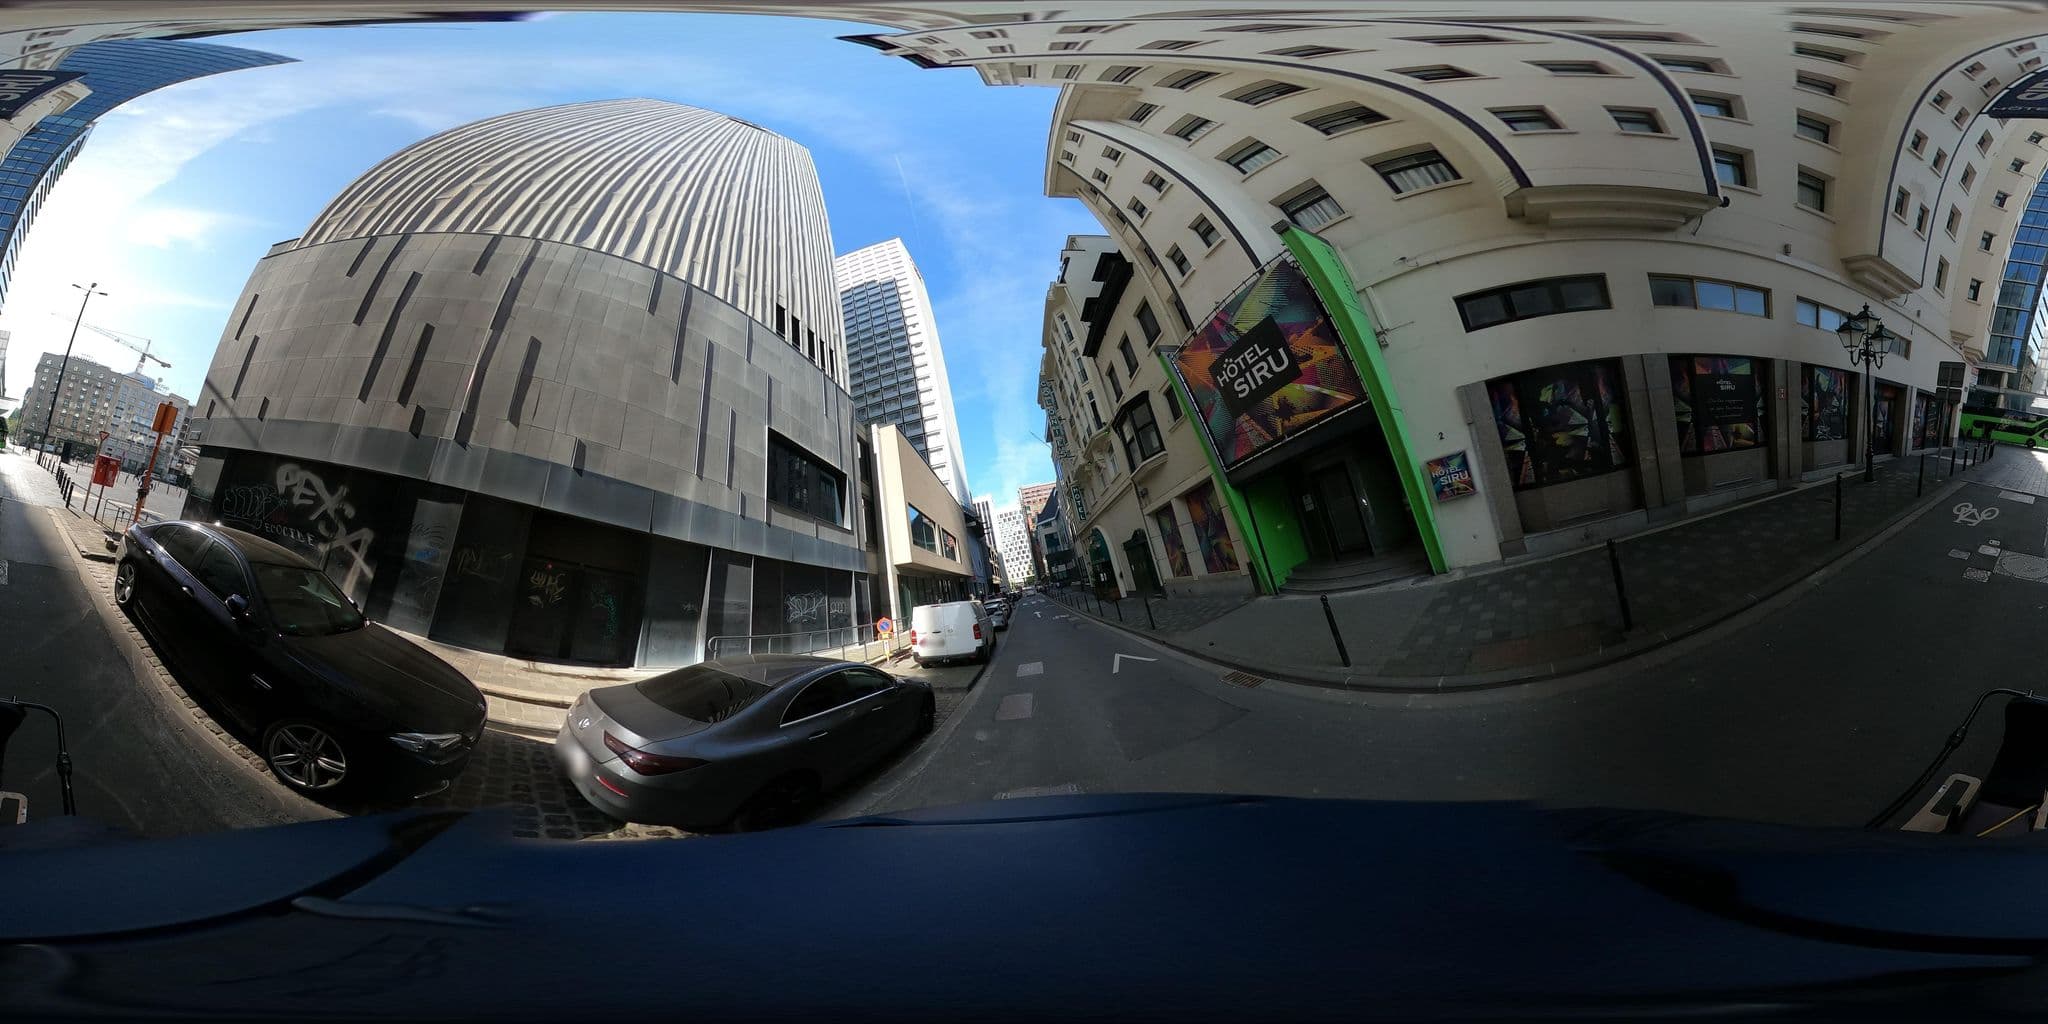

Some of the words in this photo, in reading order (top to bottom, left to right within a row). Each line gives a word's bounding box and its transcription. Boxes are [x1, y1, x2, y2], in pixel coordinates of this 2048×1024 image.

[1233, 347, 1290, 399] SIRU
[1438, 431, 1445, 440] 2
[1440, 470, 1469, 485] SIRU
[1073, 487, 1086, 520] HOTEL
